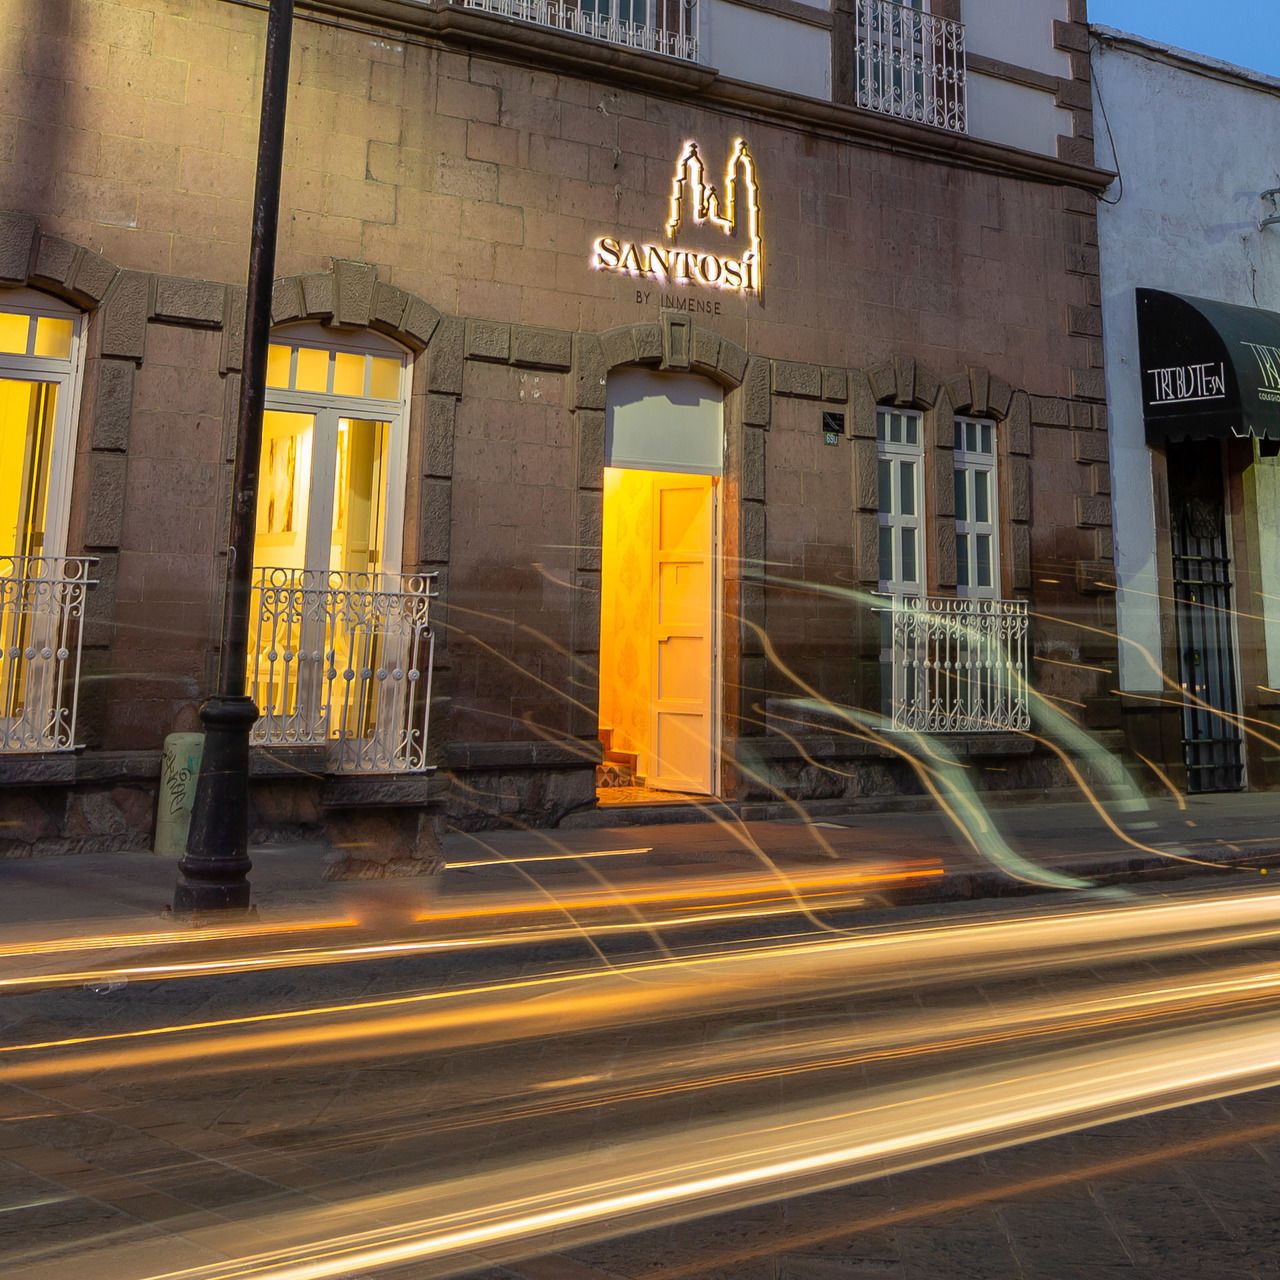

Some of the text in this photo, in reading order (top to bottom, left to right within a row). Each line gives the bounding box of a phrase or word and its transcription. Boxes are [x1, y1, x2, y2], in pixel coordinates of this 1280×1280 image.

[636, 291, 722, 315] BY INMENSE
[1258, 392, 1280, 402] COLEGIO
